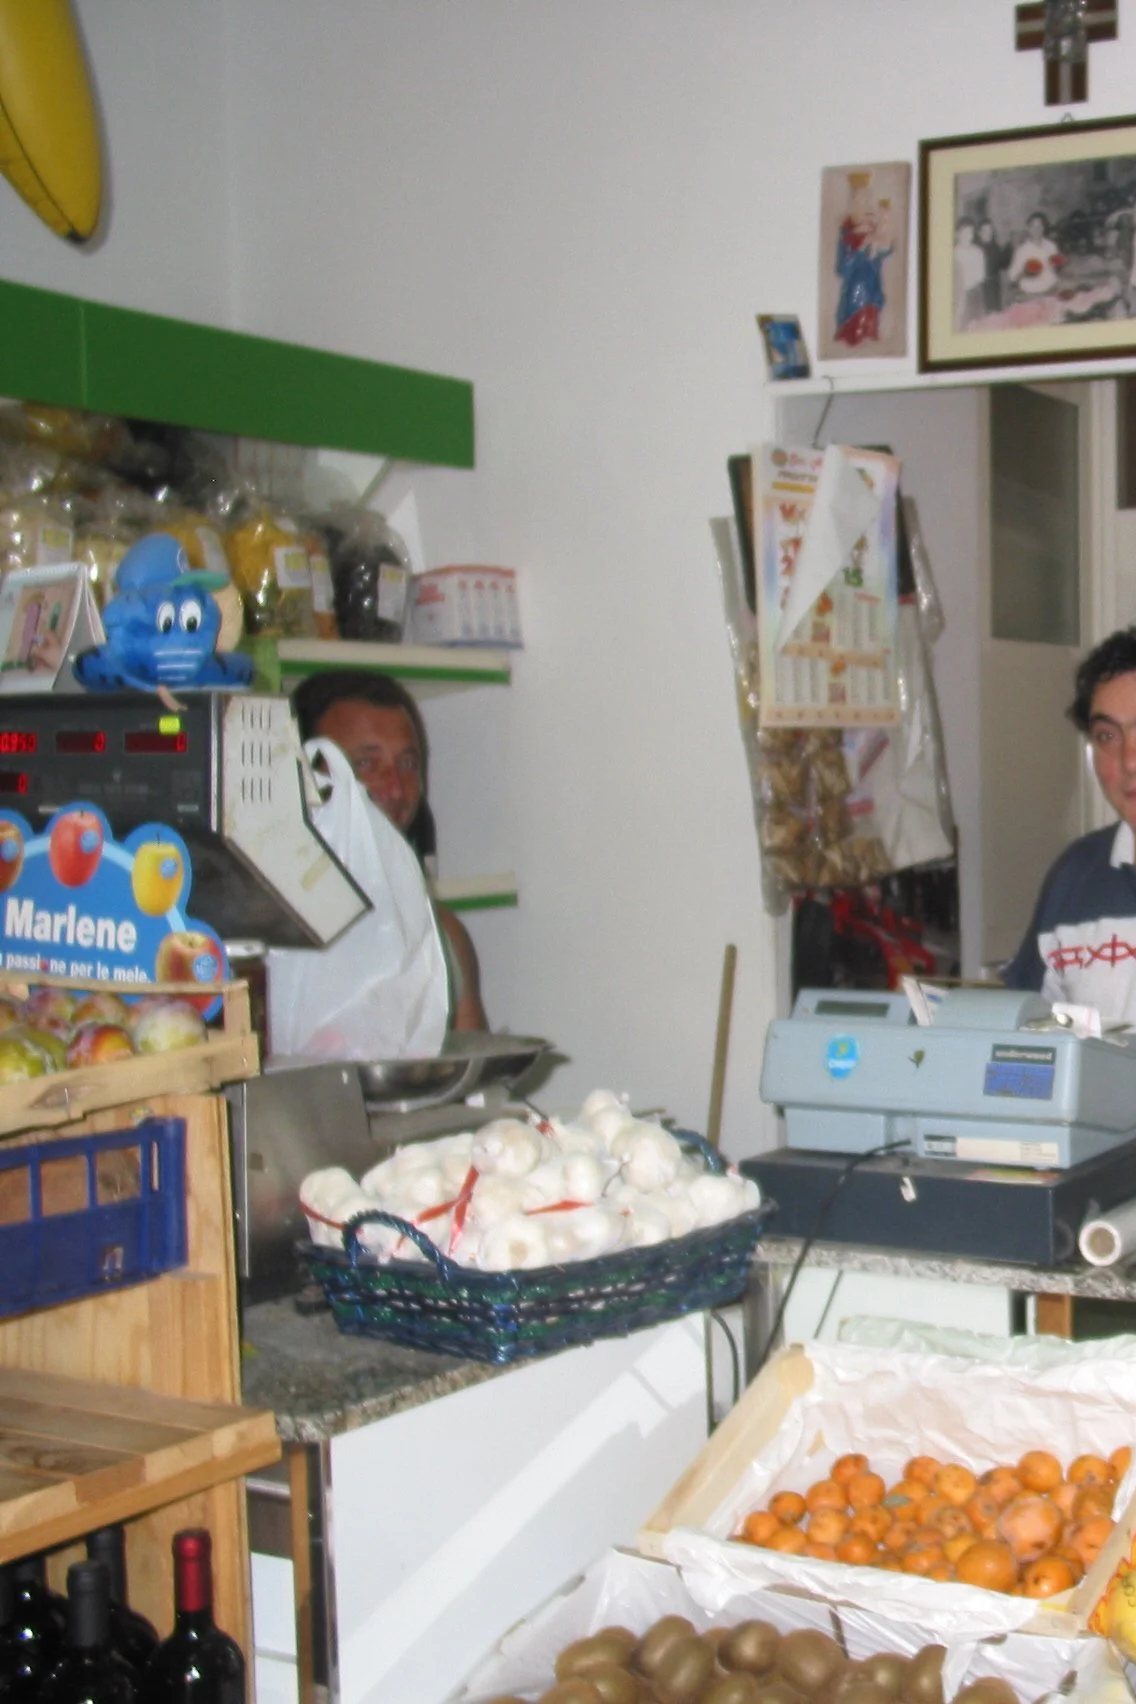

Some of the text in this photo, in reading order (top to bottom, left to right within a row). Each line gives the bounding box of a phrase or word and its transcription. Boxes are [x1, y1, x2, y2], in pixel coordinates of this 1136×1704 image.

[4, 897, 138, 953] Marlene
[70, 962, 94, 980] per
[97, 962, 110, 981] le
